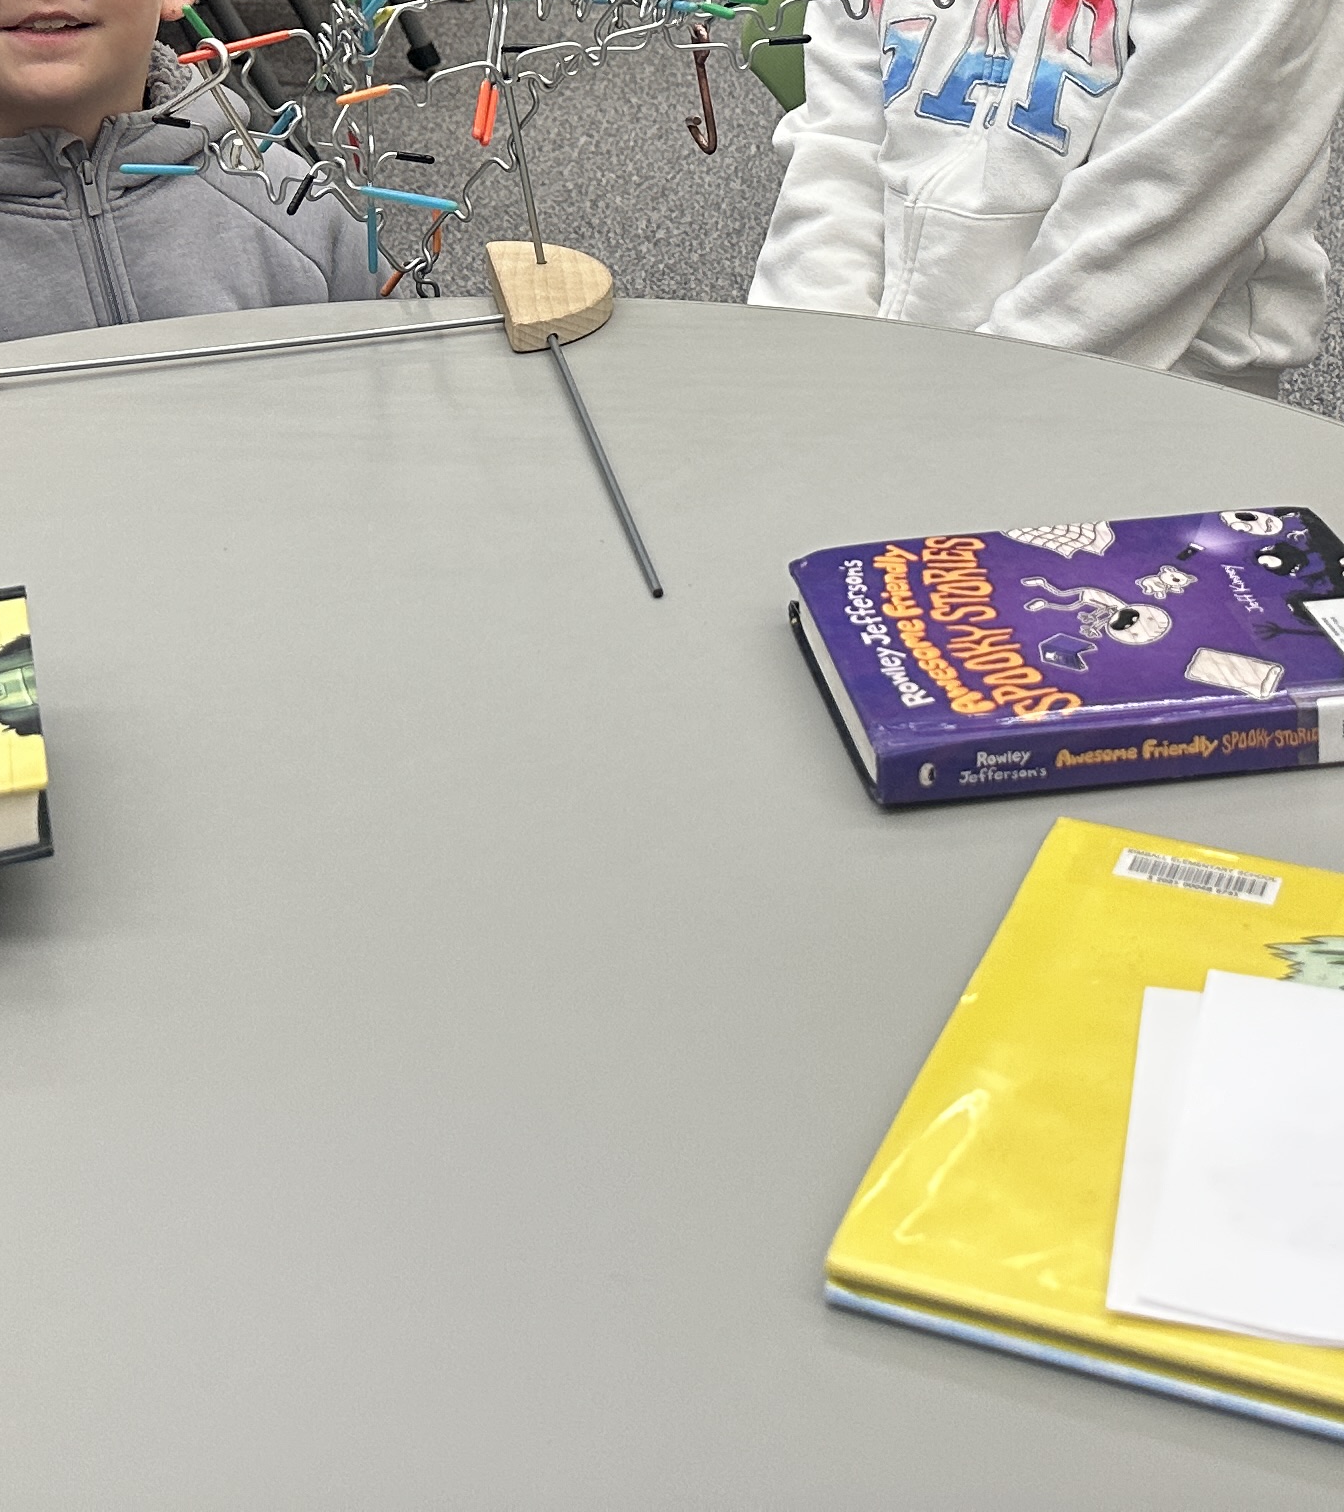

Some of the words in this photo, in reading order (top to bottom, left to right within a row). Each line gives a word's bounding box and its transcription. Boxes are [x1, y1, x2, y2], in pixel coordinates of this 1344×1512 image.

[843, 559, 893, 646] Jefferson's
[870, 544, 924, 618] Friendly
[922, 536, 998, 624] STORIES
[875, 645, 936, 709] Rowley
[896, 618, 998, 716] Awesome
[946, 625, 1085, 724] SPOOKY
[958, 766, 1048, 786] Jefferson's
[976, 749, 1032, 768] Rowley
[1056, 746, 1138, 769] Awesome
[1142, 734, 1220, 761] Friendly
[1222, 727, 1273, 754] SPOOKY
[1274, 727, 1319, 748] STORIE
[1170, 856, 1234, 873] ELEMENTARY
